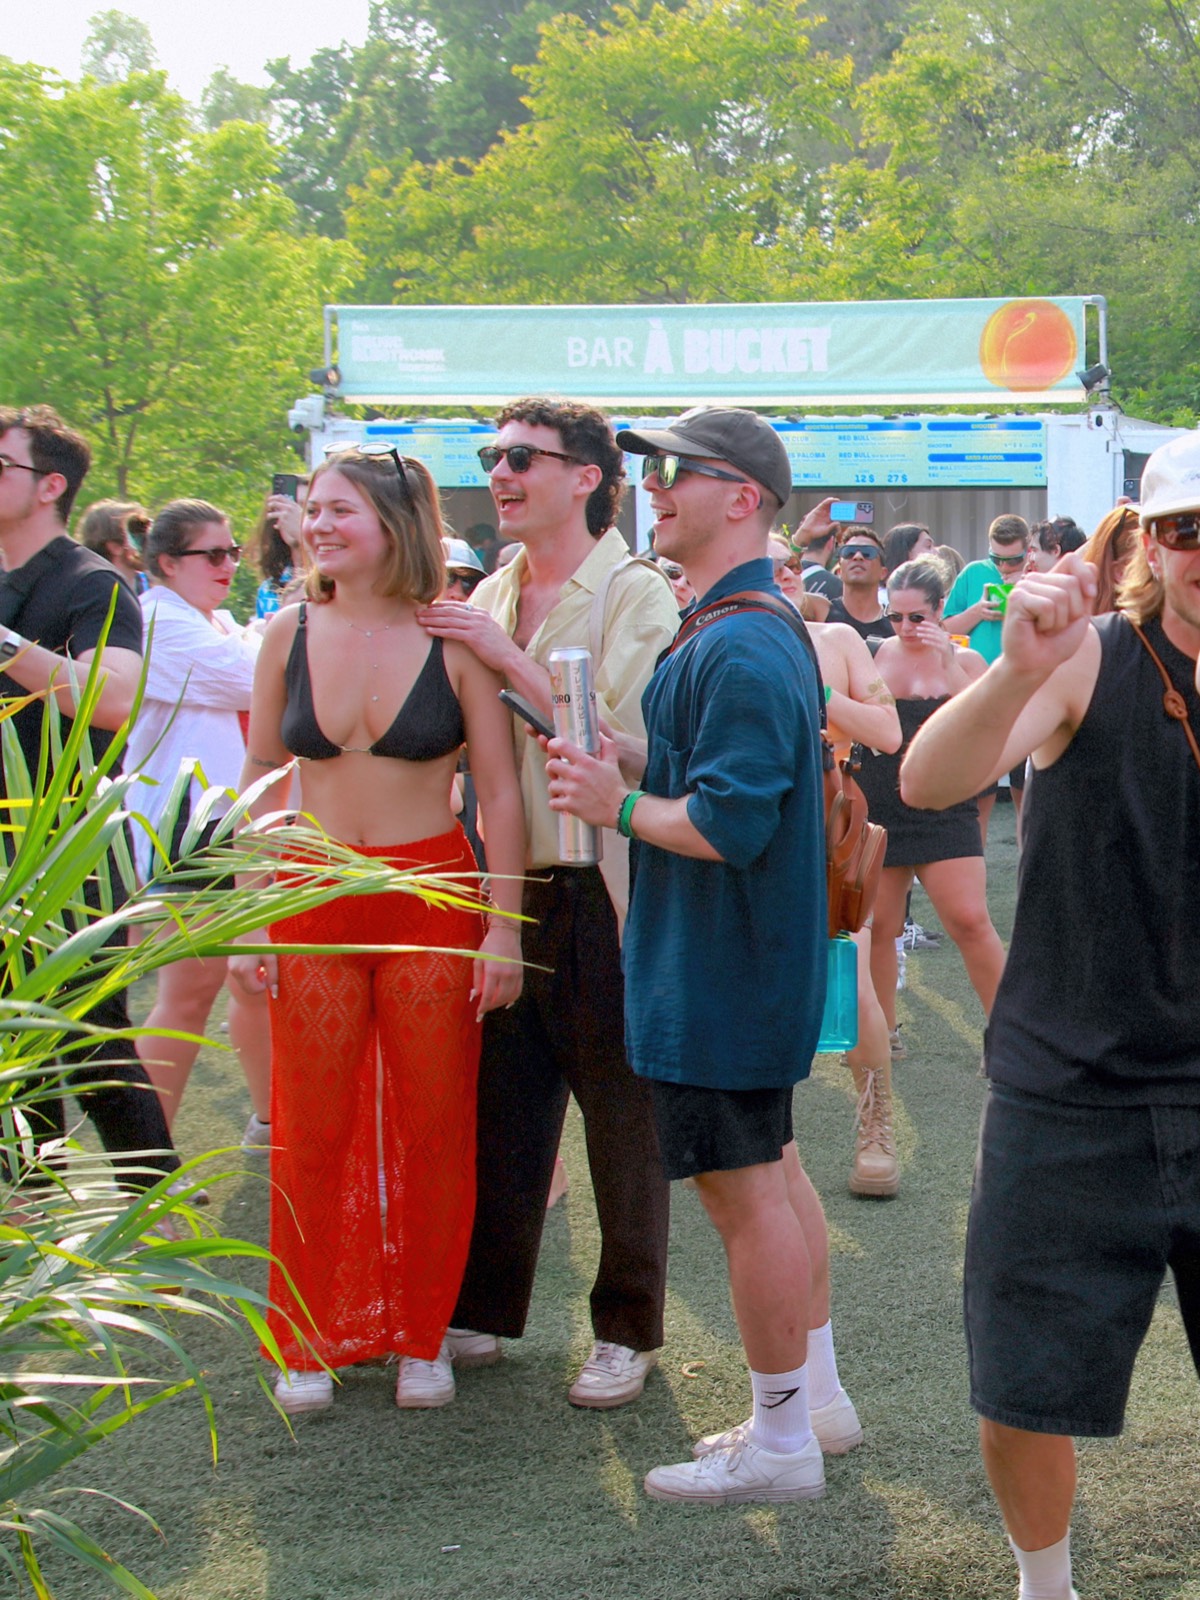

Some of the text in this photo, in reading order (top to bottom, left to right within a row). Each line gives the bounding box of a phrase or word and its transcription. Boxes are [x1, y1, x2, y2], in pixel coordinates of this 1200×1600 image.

[567, 318, 831, 375] BAR À BUCKET
[460, 475, 470, 483] 12
[855, 474, 875, 483] 12 $
[888, 474, 908, 483] 27 $
[695, 605, 738, 626] Canon
